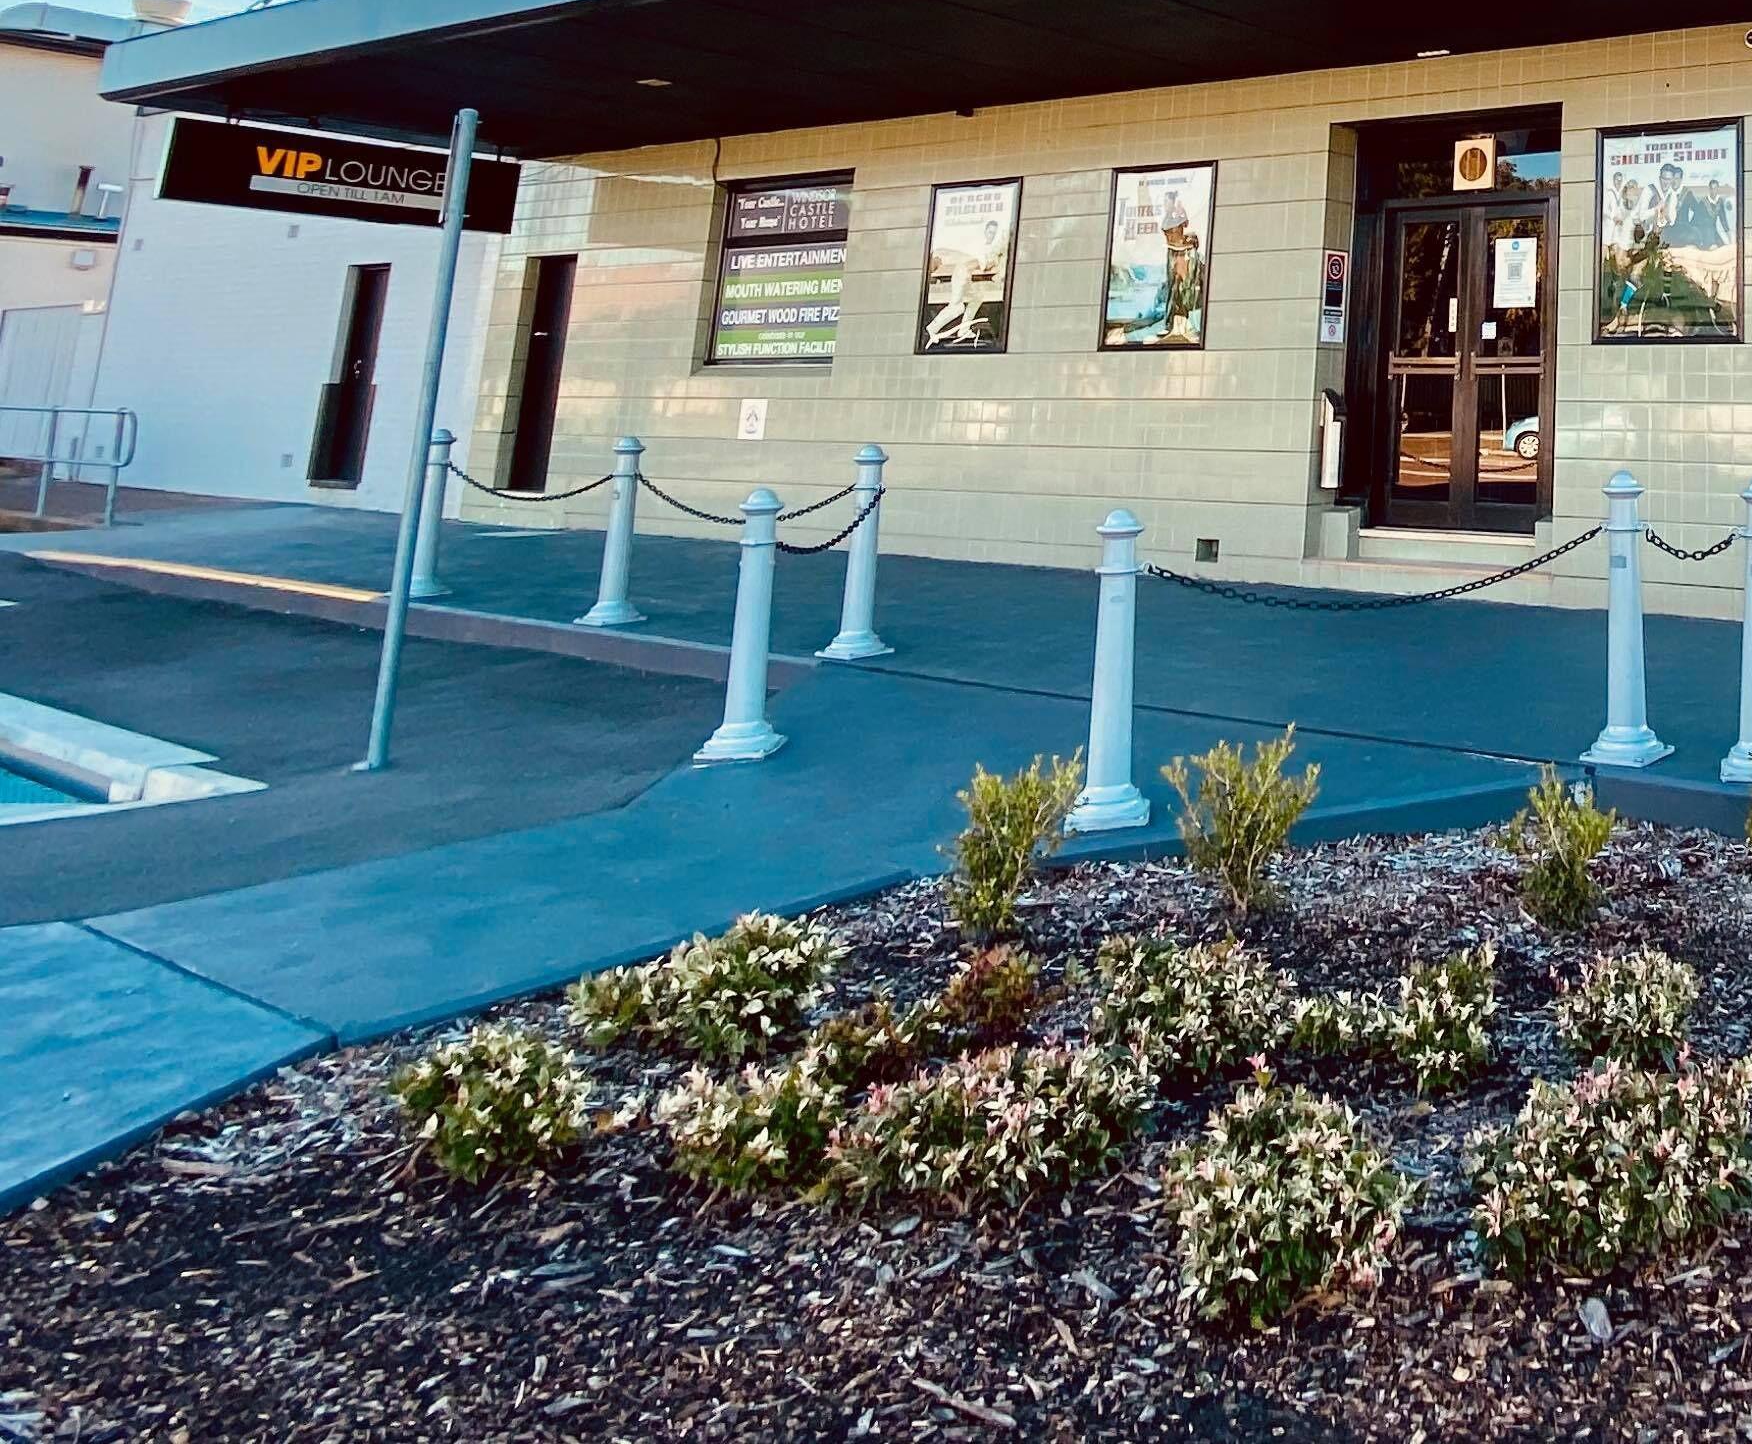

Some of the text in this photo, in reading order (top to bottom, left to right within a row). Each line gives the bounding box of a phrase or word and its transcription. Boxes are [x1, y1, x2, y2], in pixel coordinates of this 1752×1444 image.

[256, 146, 449, 193] VIP LOUNGE
[296, 182, 405, 205] OPEN TILL 1AM
[789, 201, 836, 217] CASTLE
[788, 215, 834, 230] HOTEL
[730, 254, 756, 270] LIVE
[725, 283, 762, 299] MOUTH
[764, 279, 819, 297] WATERING
[721, 309, 768, 325] GOURMET
[767, 307, 798, 324] WOOD
[799, 306, 822, 323] FIRE
[718, 343, 753, 356] STYLISH
[752, 341, 798, 356] FUNCTION
